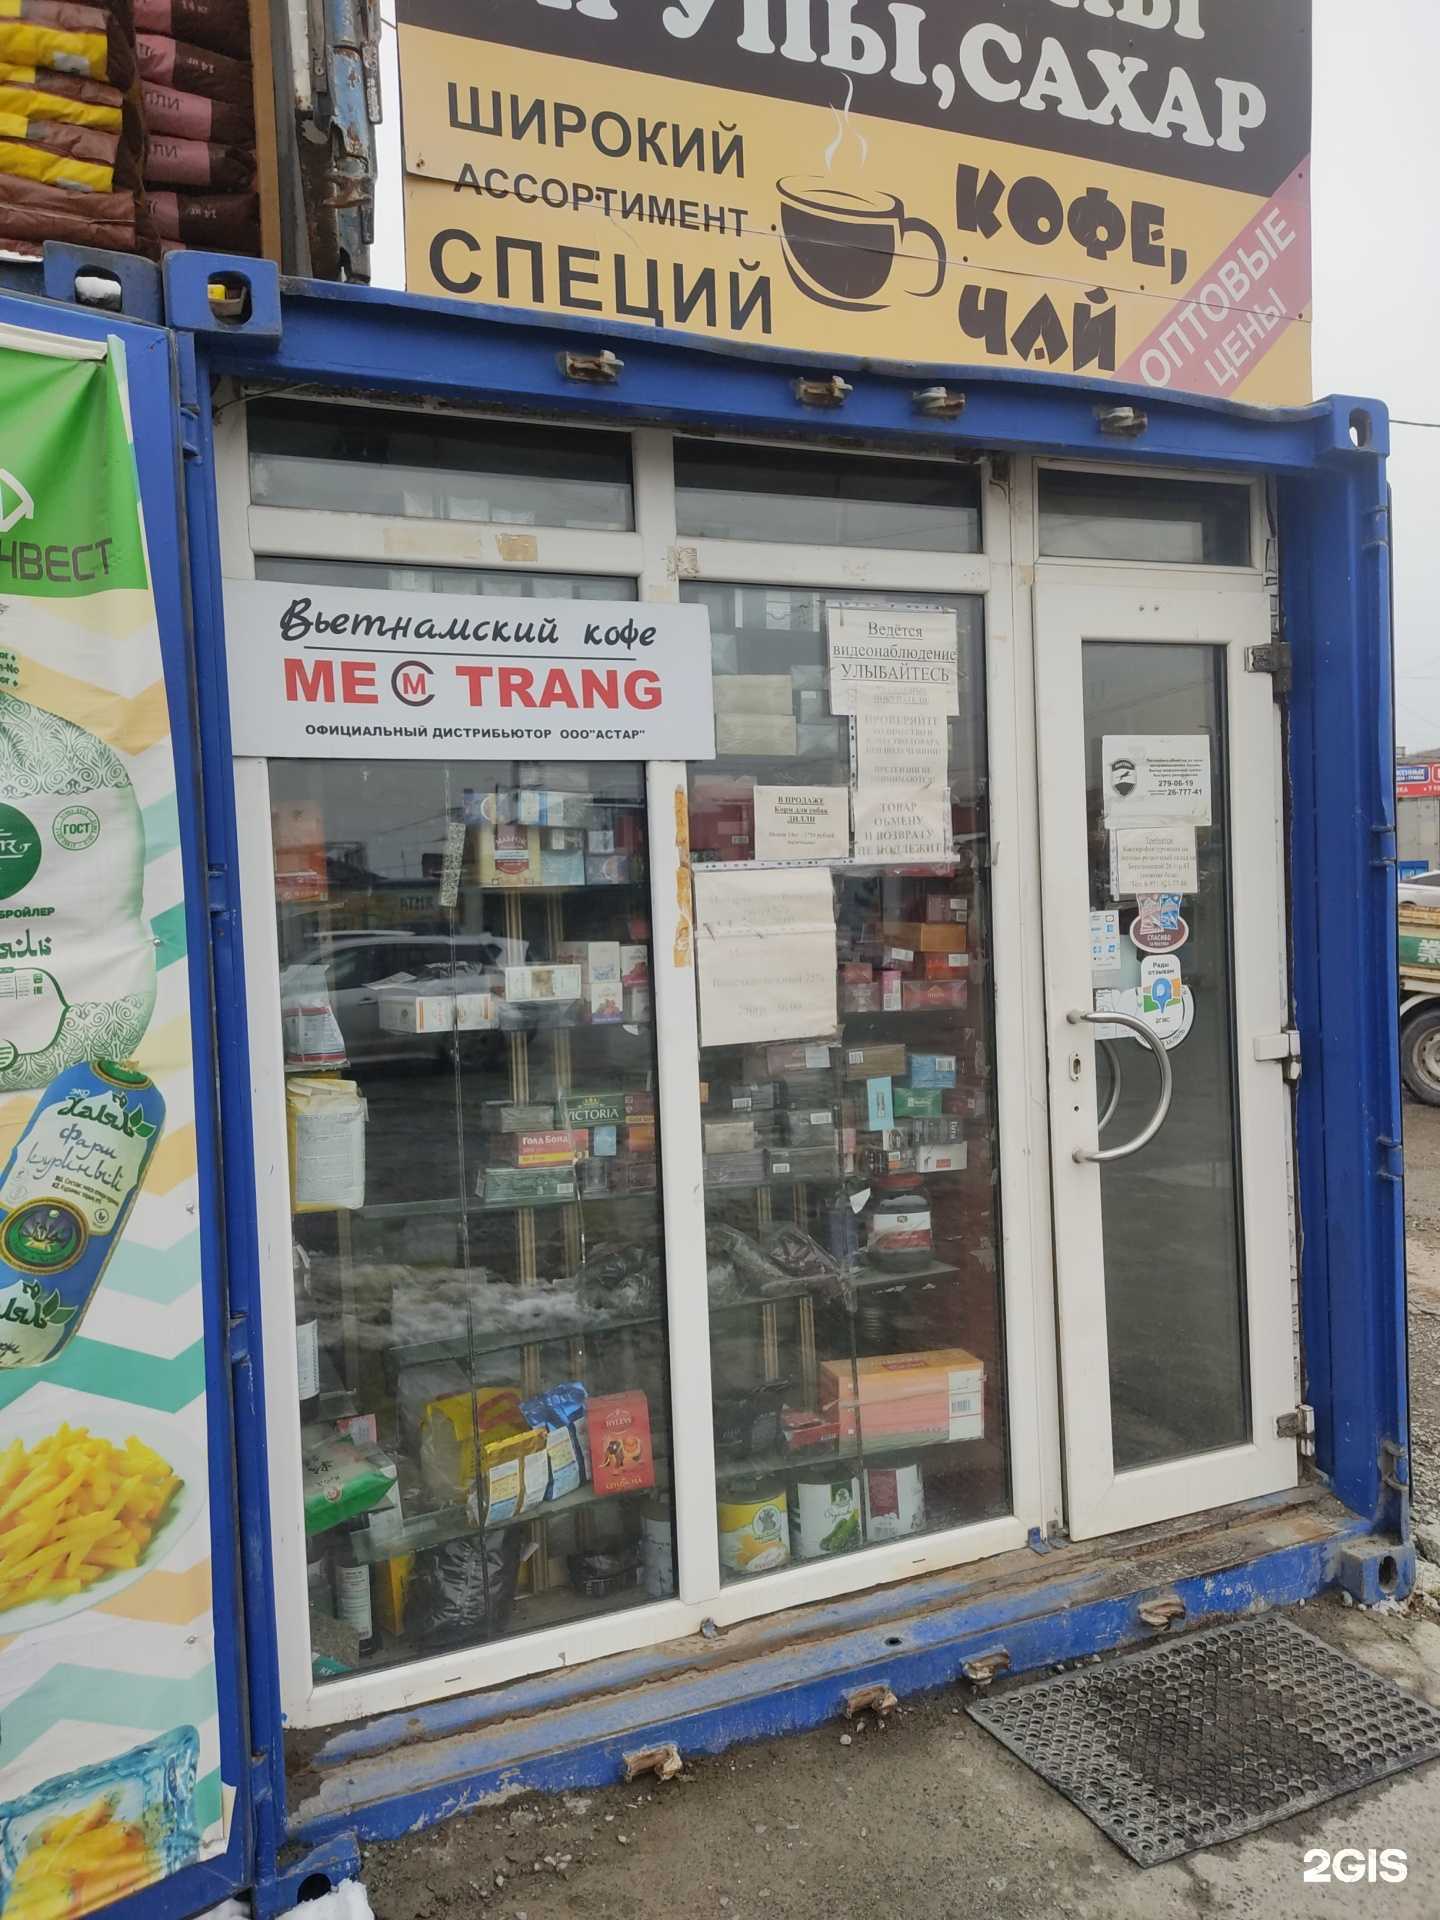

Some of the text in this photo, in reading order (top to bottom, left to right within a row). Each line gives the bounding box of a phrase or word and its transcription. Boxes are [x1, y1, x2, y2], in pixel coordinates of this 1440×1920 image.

[447, 82, 745, 178] ШИРОКИЙ
[453, 163, 749, 237] АССОРТИМЕНТ
[955, 163, 1188, 285] КОФЕ,
[429, 228, 772, 335] СПЕЦИЙ
[1139, 208, 1297, 388] ОПТОВЫЕ
[958, 285, 1117, 372] ЧАЙ
[1203, 288, 1288, 387] ЦЕНЫ
[279, 597, 657, 648] Вьетнамский кофе
[832, 643, 957, 661] видеонаблюдение
[867, 621, 923, 637] Ведётся
[283, 657, 379, 704] ME
[455, 665, 663, 710] TRANG
[840, 663, 950, 681] УЛЫБАЙТЕСЬ
[305, 724, 428, 738] ОФИЦИАЛЬНЫЙ
[432, 727, 552, 740] ДИСТРИБЬЮТОР
[63, 823, 91, 835] ГОСТ
